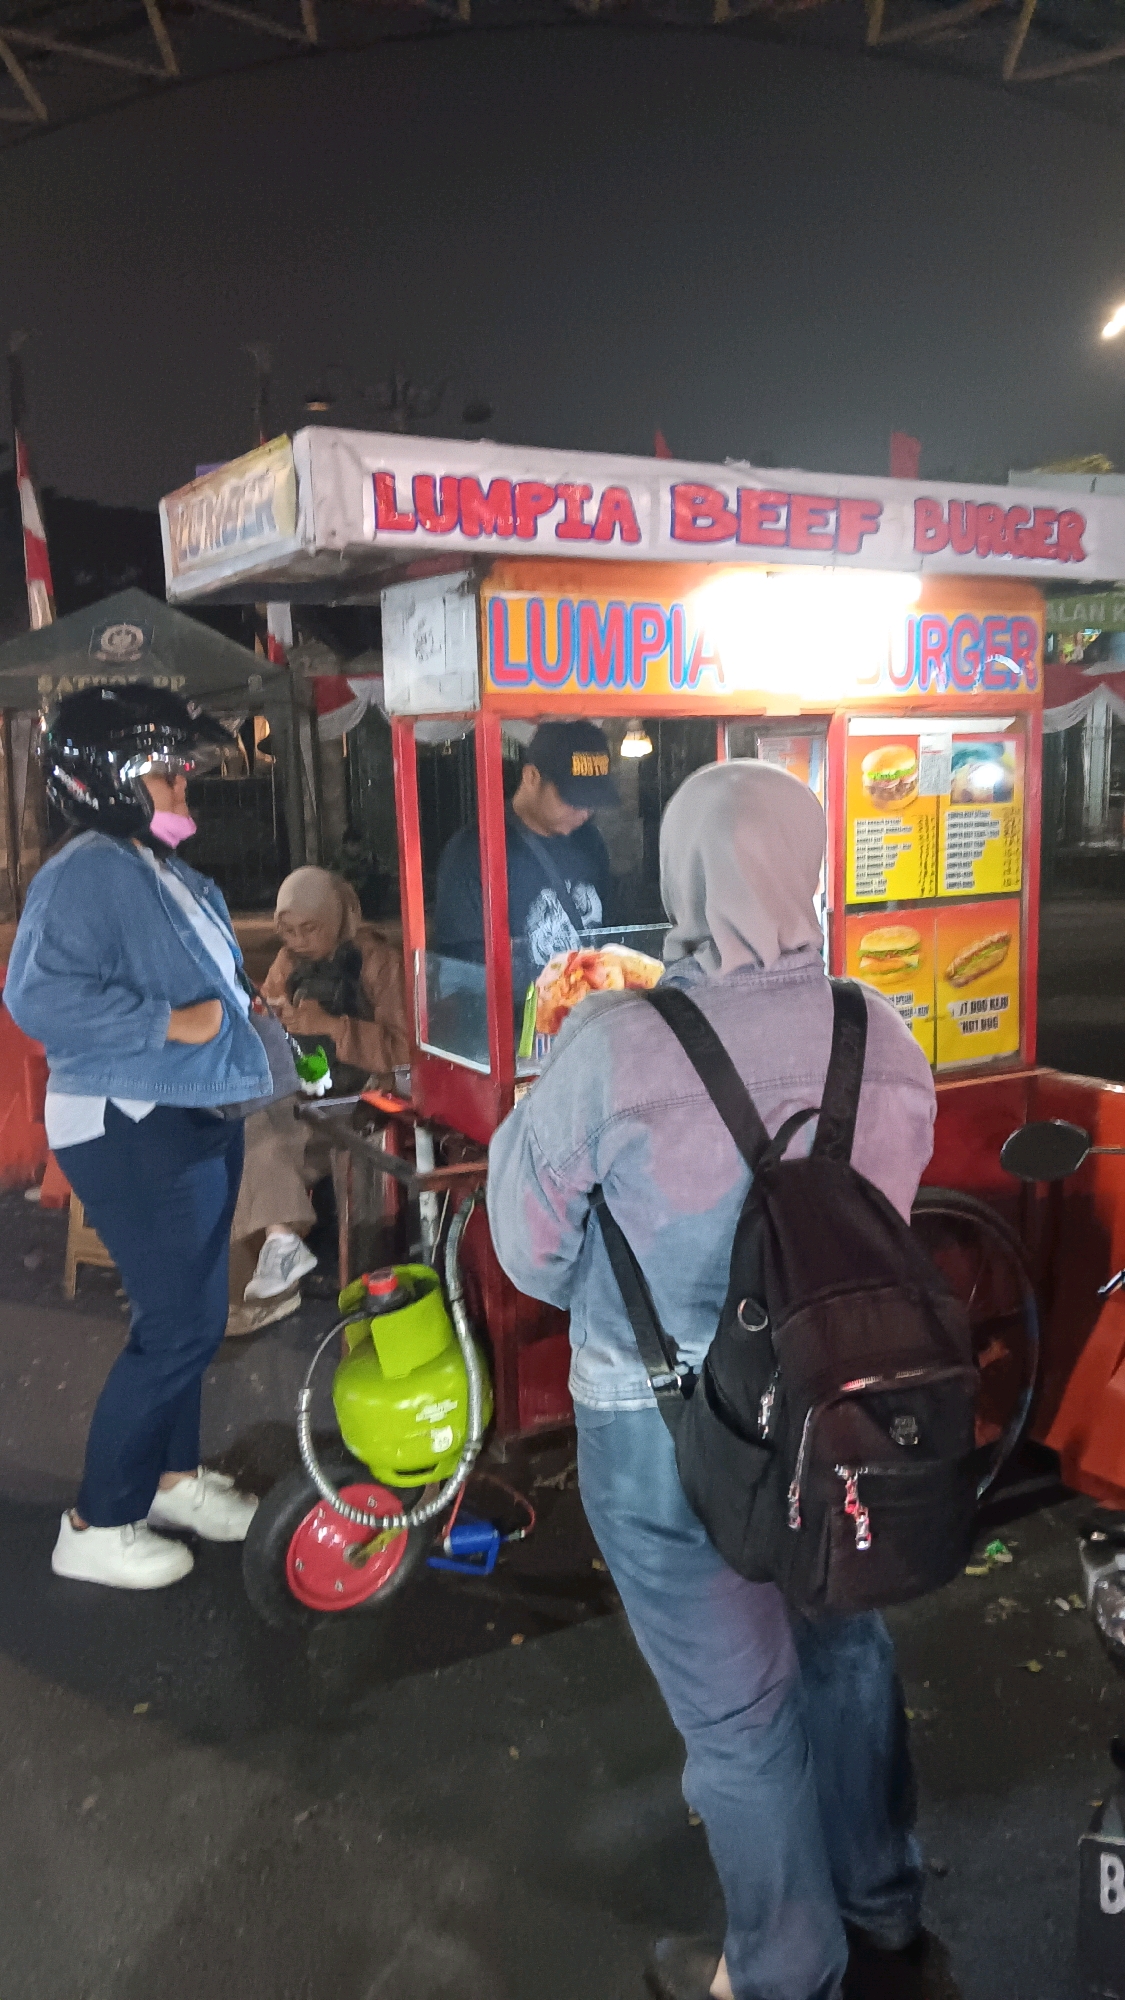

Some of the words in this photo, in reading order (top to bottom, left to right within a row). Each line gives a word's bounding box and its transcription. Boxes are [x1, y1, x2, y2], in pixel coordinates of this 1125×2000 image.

[372, 472, 642, 543] LUMPIA
[670, 482, 883, 554] BEEF
[913, 497, 1086, 563] BURGER
[488, 597, 726, 691] LUMPIA
[855, 613, 1038, 693] URGER
[1100, 1851, 1125, 1915] B
